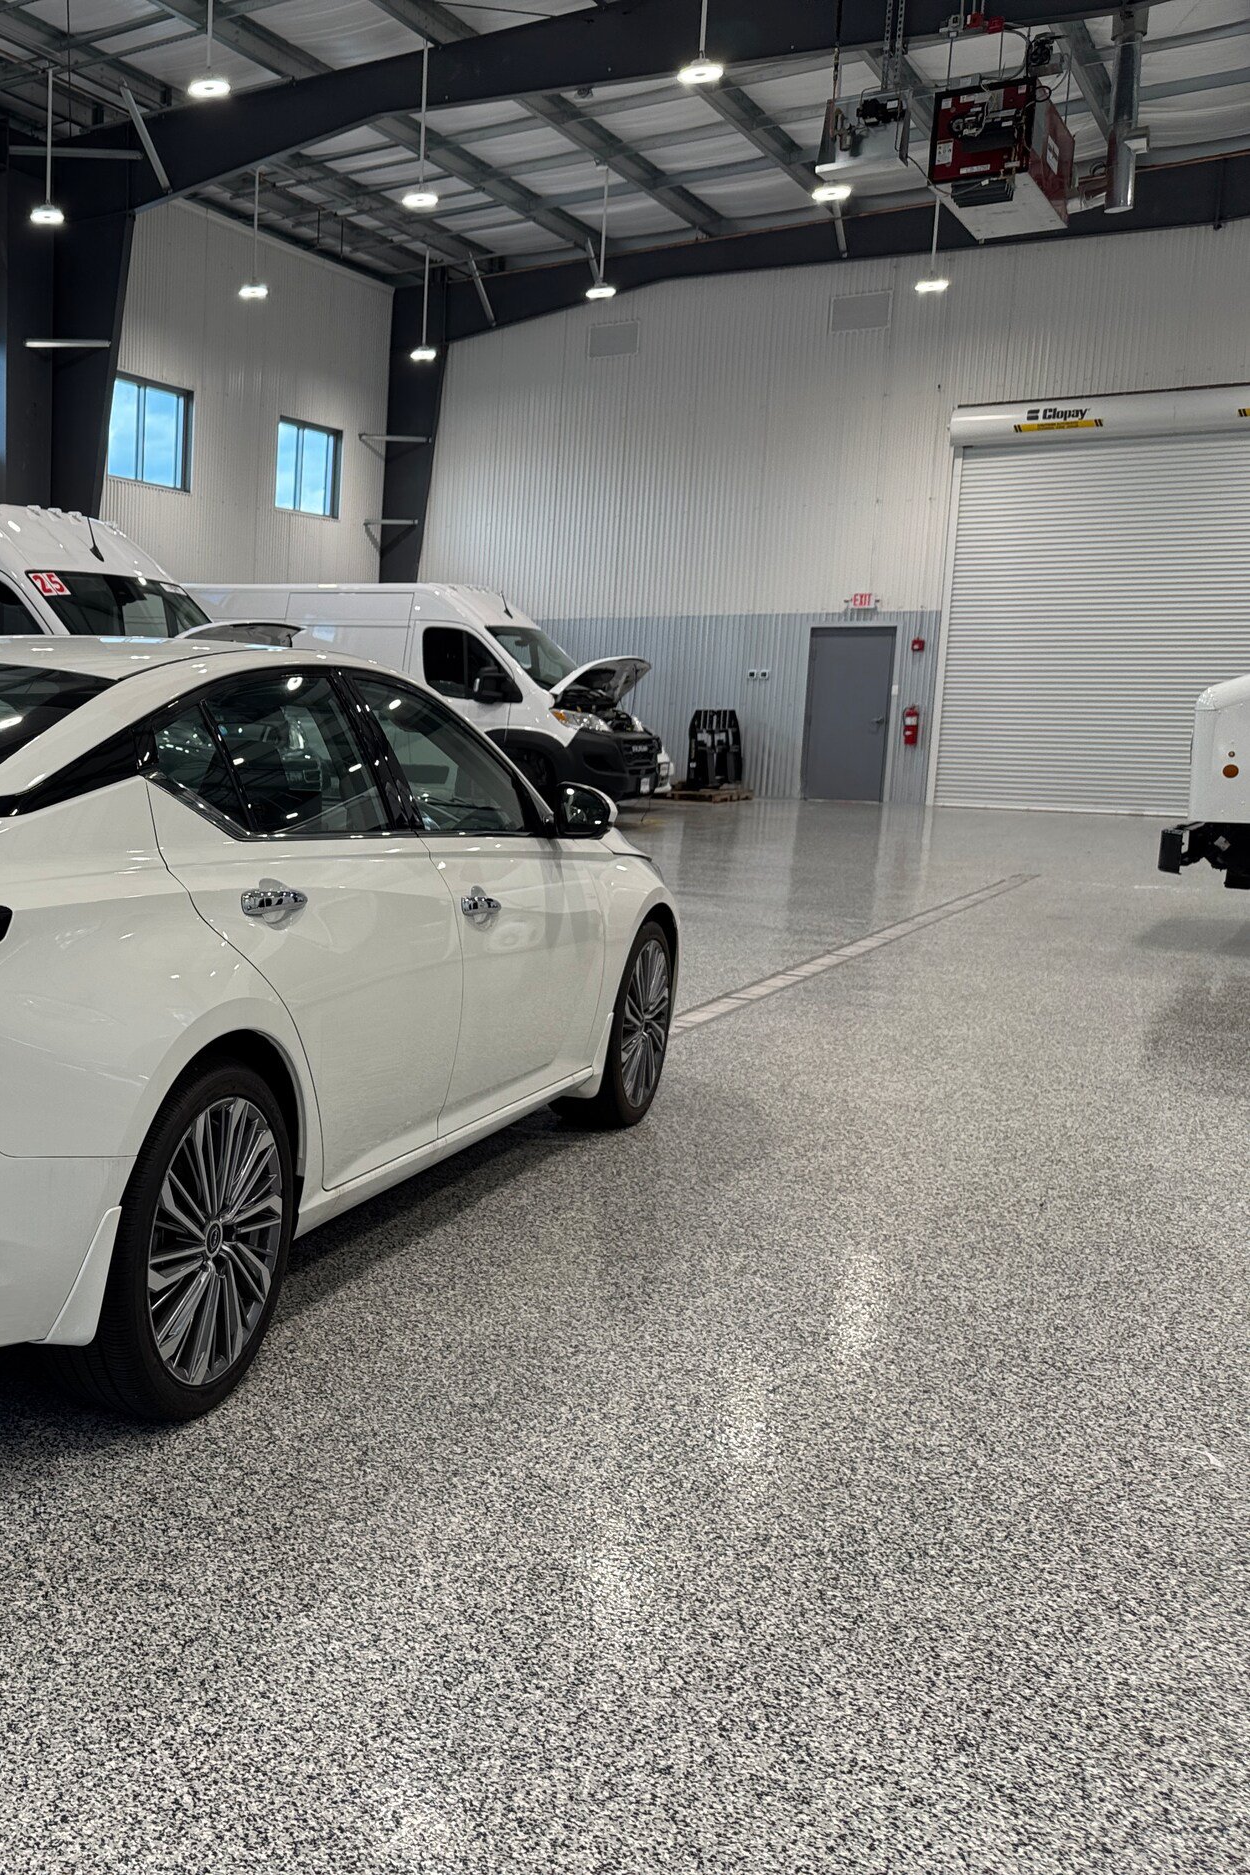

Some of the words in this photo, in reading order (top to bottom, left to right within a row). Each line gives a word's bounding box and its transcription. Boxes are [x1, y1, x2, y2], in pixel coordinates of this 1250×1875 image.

[1042, 407, 1088, 421] Clopay
[32, 574, 65, 593] 25
[853, 593, 872, 606] EXIT
